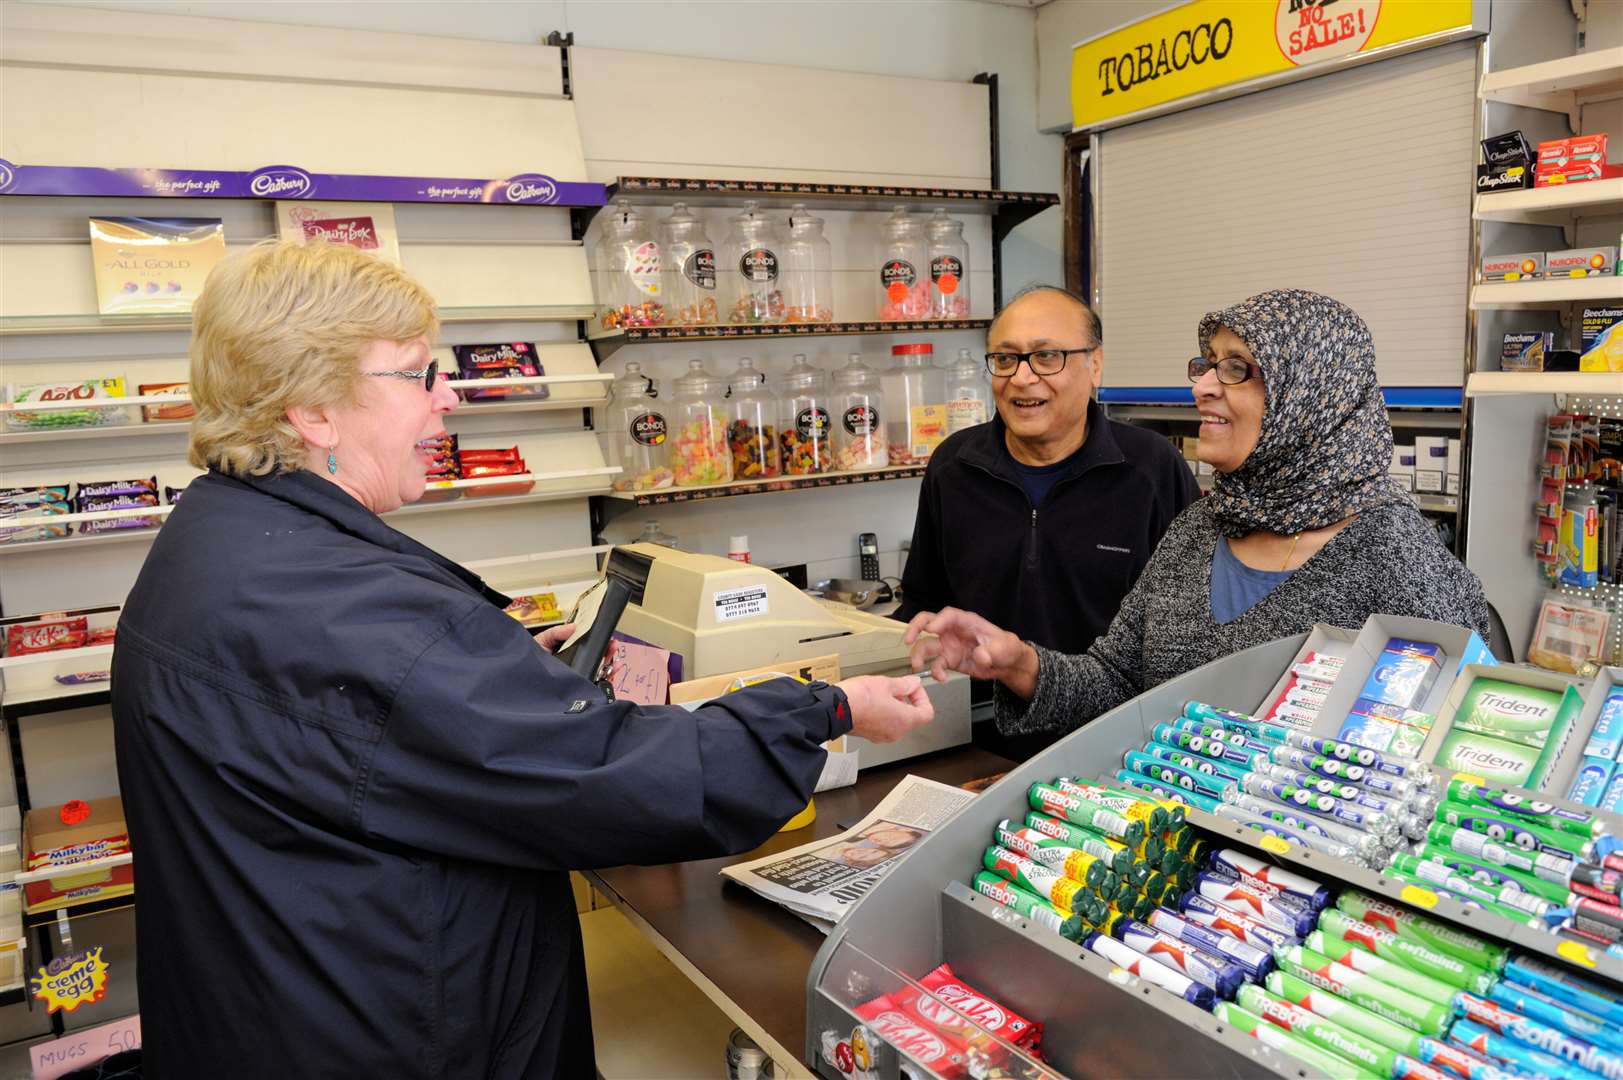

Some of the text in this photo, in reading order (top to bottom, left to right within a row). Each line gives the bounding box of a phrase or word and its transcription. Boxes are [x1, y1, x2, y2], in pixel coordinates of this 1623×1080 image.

[1299, 5, 1323, 28] NO
[1289, 9, 1365, 56] SALE!
[1099, 17, 1232, 97] TOBACCO
[155, 180, 219, 195] the perfect gift
[251, 175, 309, 196] Cadbury
[507, 182, 552, 200] Cadbury
[1478, 172, 1522, 187] ChapStick
[428, 186, 482, 199] the perfect gift
[311, 227, 348, 244] Dairy
[111, 259, 191, 270] ALL GOLD
[745, 257, 774, 266] BONDS
[884, 267, 912, 277] BONDS
[933, 262, 960, 272] BONDS
[1485, 262, 1520, 272] NUROFEN
[1550, 257, 1587, 267] NUROFEN
[471, 346, 519, 364] Dairy Milk
[637, 421, 666, 431] BONDS
[86, 482, 132, 500] Dairy Milk
[88, 501, 114, 514] Dairy
[1479, 693, 1549, 718] Trident
[1180, 733, 1224, 758] POLO
[1202, 724, 1246, 747] POLO
[1322, 739, 1375, 766] POLO
[1454, 745, 1525, 772] Trident
[1151, 764, 1194, 789] POLO
[1170, 753, 1213, 777] POLO
[1310, 754, 1365, 781] POLO
[1303, 774, 1359, 796] POLO
[1036, 788, 1080, 811] TREBOR
[1280, 785, 1336, 812] POLO
[1486, 790, 1554, 814] POLO
[1031, 816, 1070, 841] TREBOR
[1472, 819, 1538, 851] POLO
[49, 841, 108, 860] Milkybar
[1000, 832, 1040, 859] TREBOR
[1215, 861, 1239, 878] EXTRA
[978, 880, 1018, 908] TREBOR
[1241, 873, 1280, 897] TREBOR
[1215, 905, 1255, 932] TREBOR
[1360, 895, 1416, 925] TREBOR
[1343, 916, 1396, 946] TREBOR
[1399, 939, 1465, 973] softmints
[46, 959, 97, 990] creme
[1297, 966, 1353, 999] TREBOR
[56, 976, 96, 999] egg
[1256, 997, 1309, 1031] TREBOR
[40, 1042, 88, 1067] MUGS
[1313, 1026, 1377, 1064] softmints
